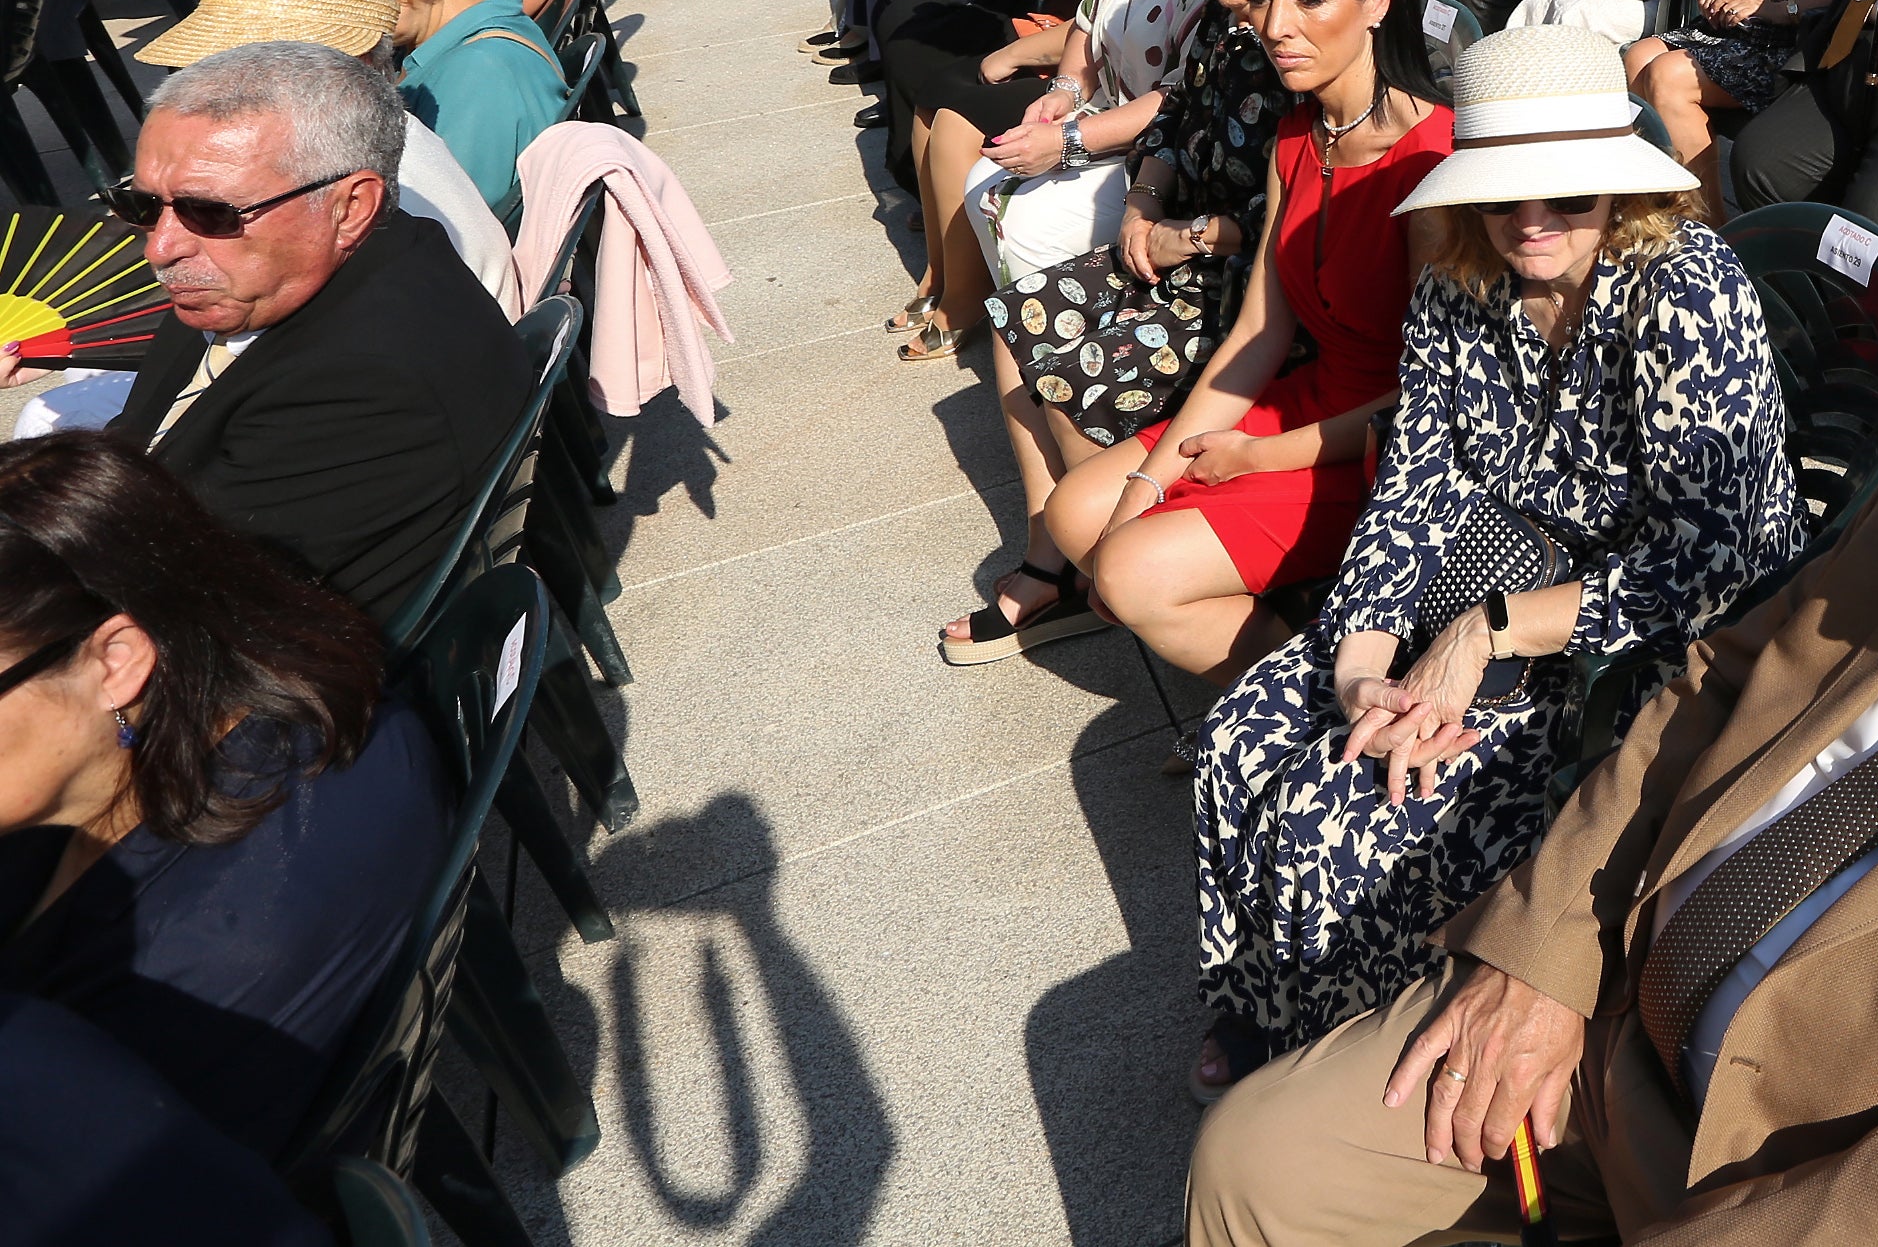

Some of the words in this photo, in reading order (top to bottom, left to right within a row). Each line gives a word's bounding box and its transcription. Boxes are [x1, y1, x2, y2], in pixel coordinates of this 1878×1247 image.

[1839, 225, 1865, 244] ACOTADO
[1864, 238, 1872, 247] C
[1830, 246, 1854, 263] ASIENTO
[1853, 256, 1862, 268] 29
